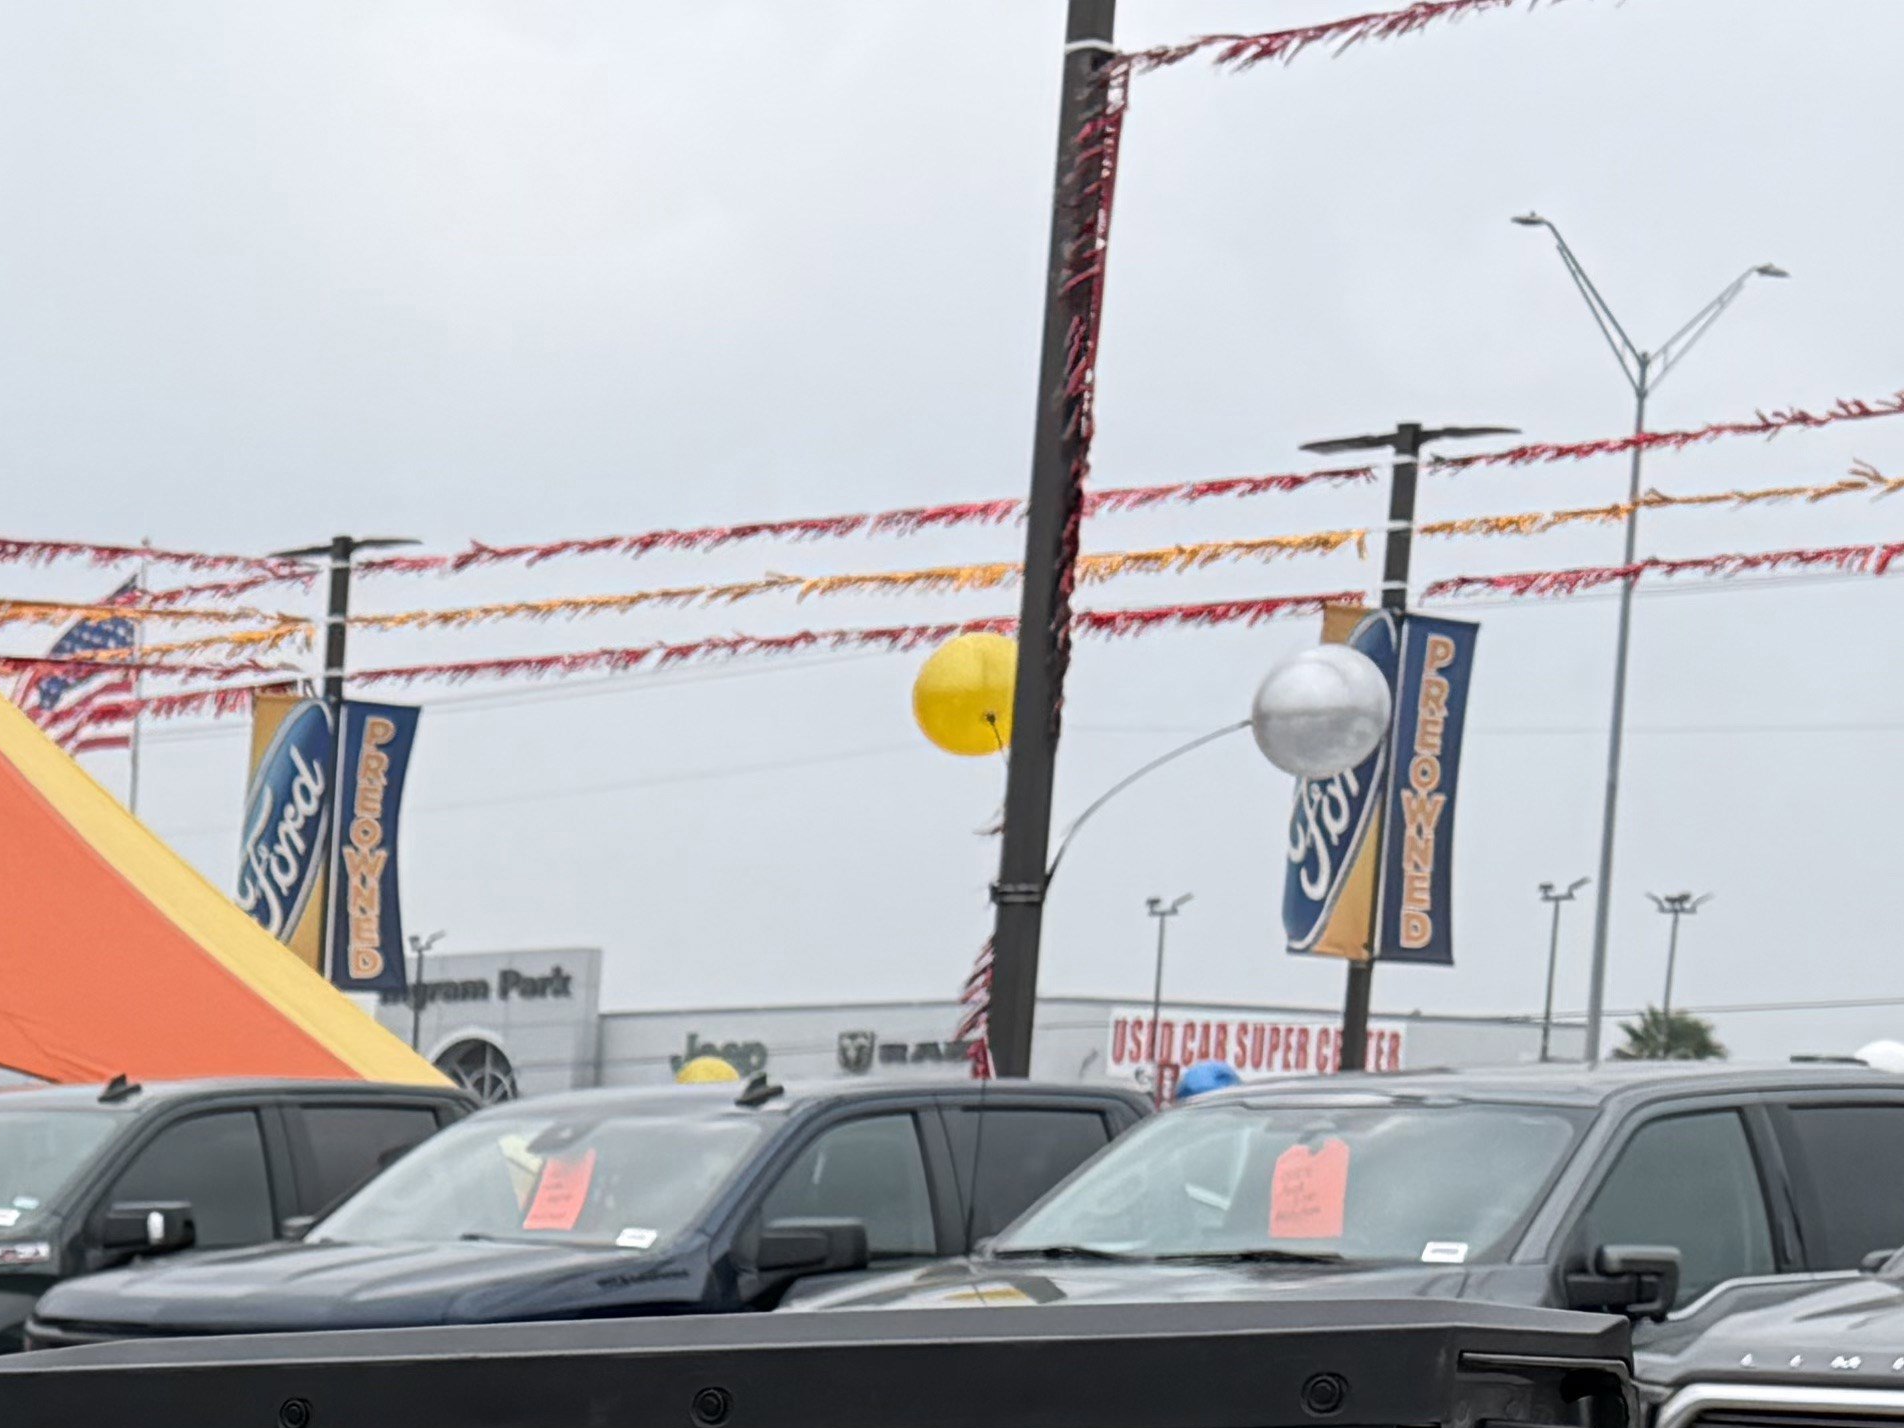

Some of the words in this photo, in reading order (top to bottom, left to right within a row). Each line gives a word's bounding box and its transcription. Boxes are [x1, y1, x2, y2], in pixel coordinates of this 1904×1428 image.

[238, 744, 326, 933] Ford
[498, 966, 572, 1000] Park
[1112, 1020, 1175, 1065] USED
[1181, 1021, 1228, 1066] CAR
[1234, 1023, 1310, 1071] SUPER
